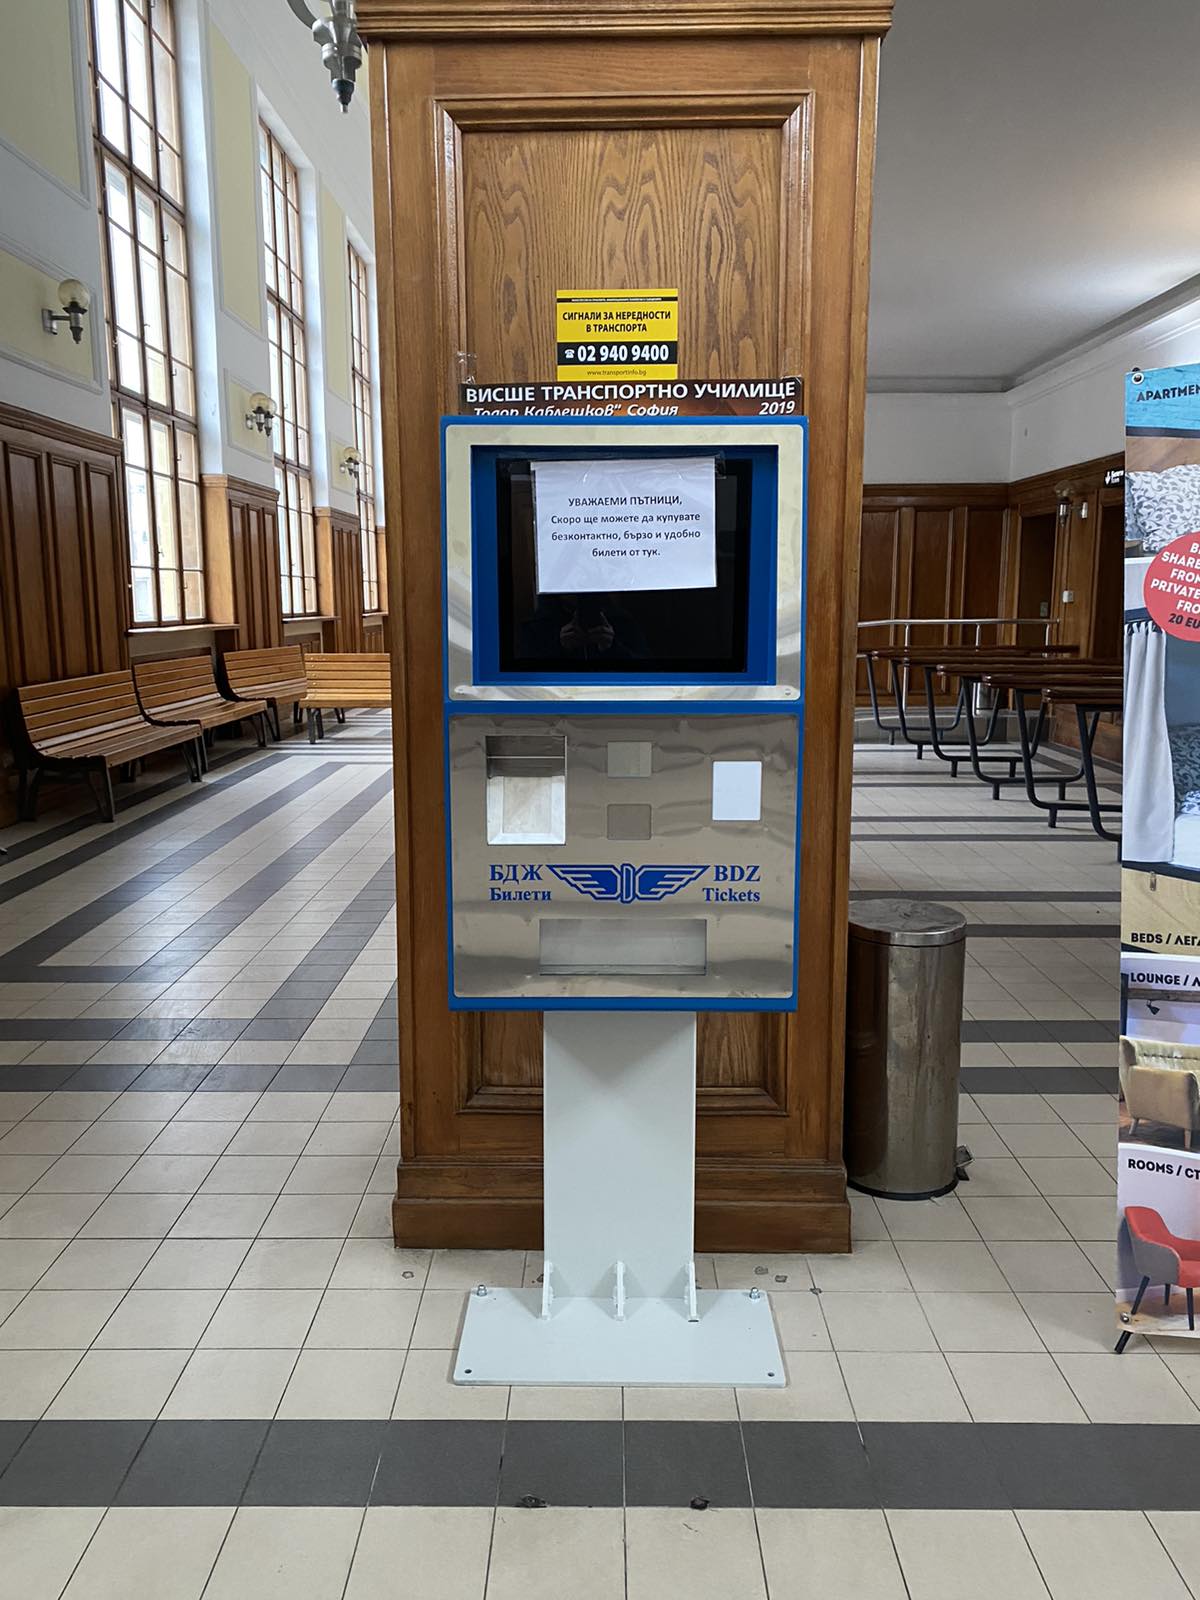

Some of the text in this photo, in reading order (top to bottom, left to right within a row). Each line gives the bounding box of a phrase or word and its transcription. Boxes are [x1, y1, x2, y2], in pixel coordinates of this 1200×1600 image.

[562, 310, 671, 321] СИГНАЛИ ЗА НЕРЕДНОСТИ
[586, 323, 647, 333] В ТРАНСПОРТА
[577, 344, 670, 362] 02 940 9400
[587, 369, 647, 377] www.transportinfo.bg
[466, 381, 796, 403] ВИСШЕ ТРАНСПОРТНО УЧИЛИЩЕ
[627, 403, 679, 417] София
[759, 400, 796, 416] 2019
[568, 495, 683, 507] УВАЖАЕМИ ПЪТНИЦИ,
[551, 513, 701, 525] Скоро ще можете да купувате
[551, 531, 622, 541] безконтактно,
[623, 530, 653, 541] бързо
[664, 529, 701, 541] удобно
[592, 548, 661, 558] билети от тук.
[1168, 613, 1183, 625] 20
[488, 864, 543, 884] БДЖ
[713, 864, 761, 882] BDZ
[489, 887, 552, 901] Билети
[702, 887, 761, 902] Tickets
[1131, 932, 1163, 944] BEDS
[1131, 972, 1181, 986] LOUNGE
[1128, 1158, 1174, 1175] ROOMS
